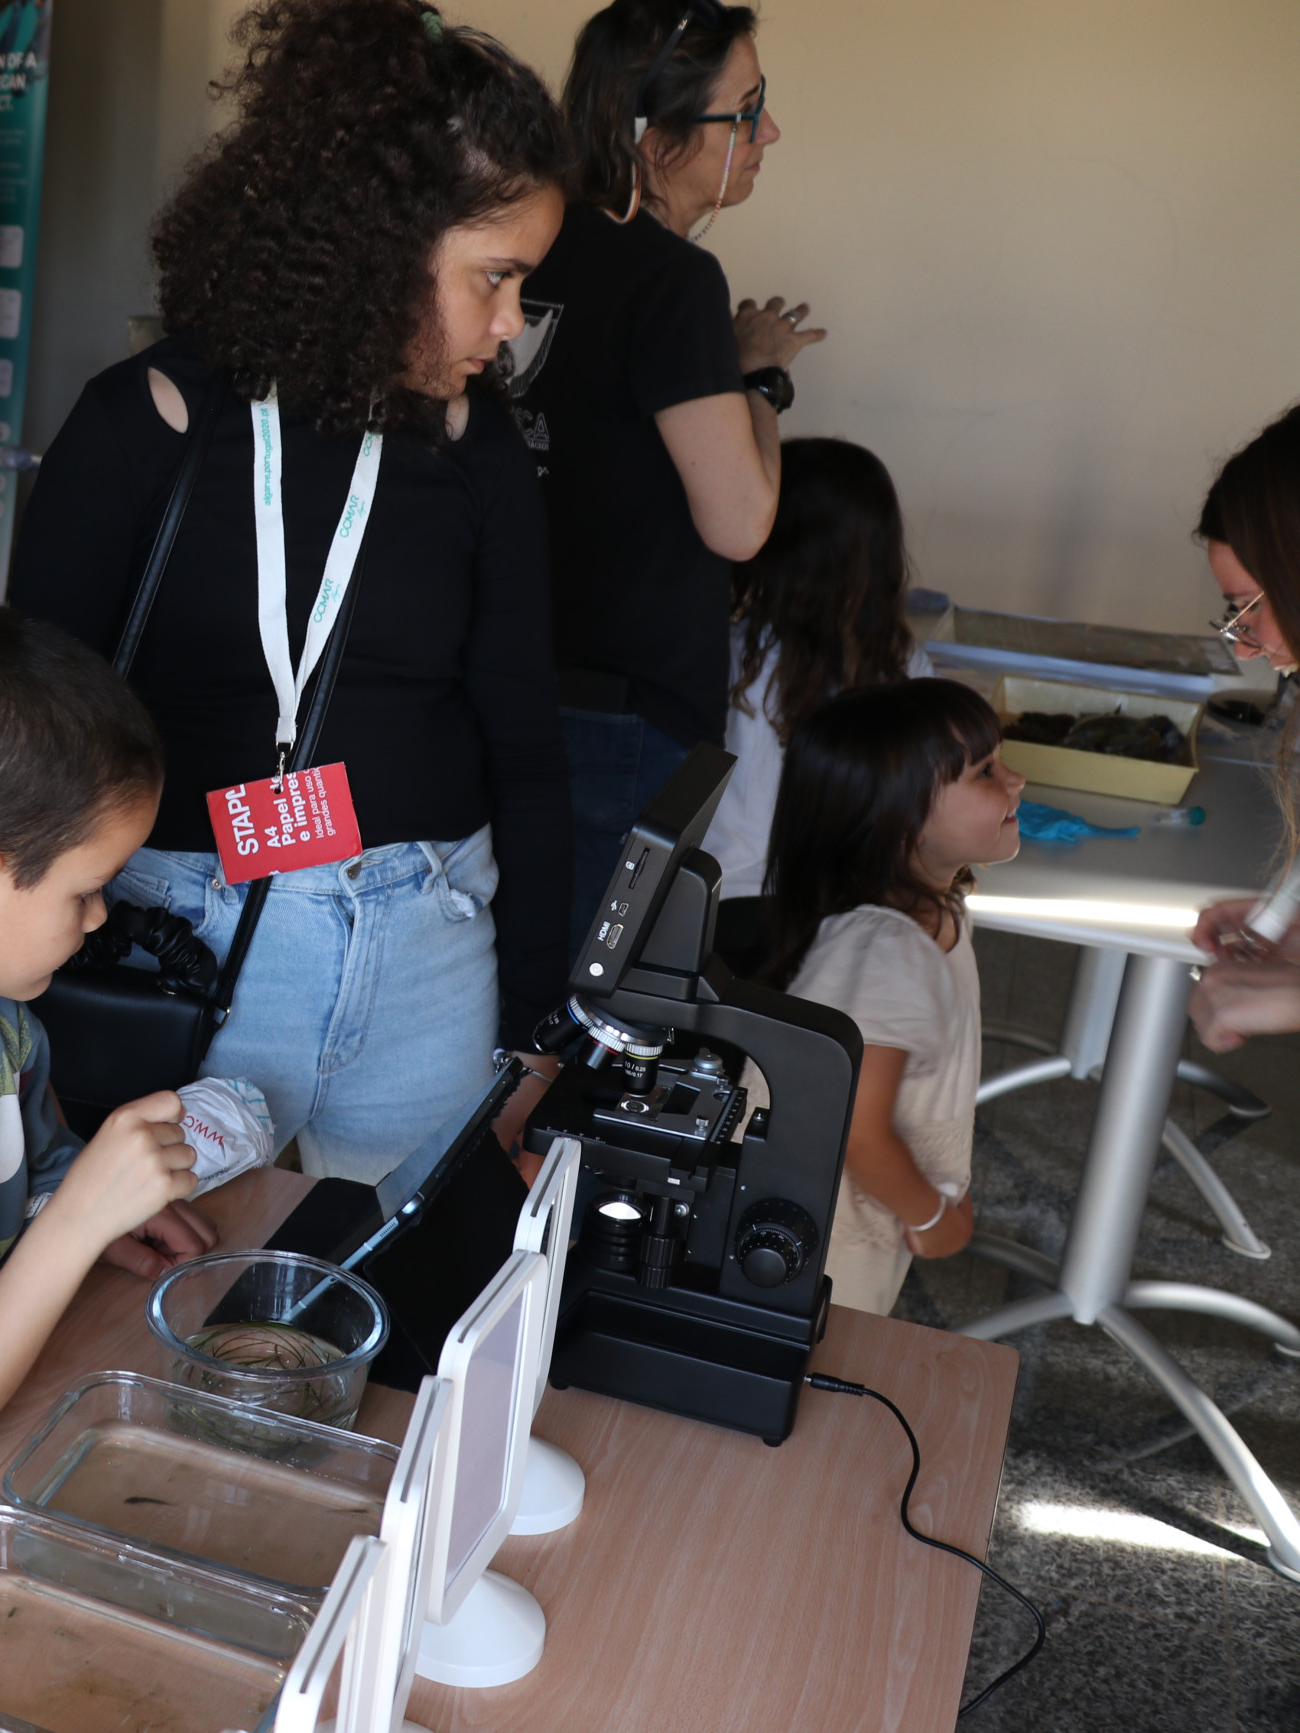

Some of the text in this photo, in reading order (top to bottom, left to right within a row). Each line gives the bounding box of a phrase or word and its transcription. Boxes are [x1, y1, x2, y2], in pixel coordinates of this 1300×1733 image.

[7, 52, 25, 69] OF
[25, 52, 37, 68] A
[260, 408, 273, 506] algarve.portugal2020.pt
[339, 494, 360, 539] CCMAR
[313, 578, 334, 624] CCMAR
[304, 776, 314, 794] uso
[308, 794, 321, 816] para
[273, 798, 296, 846] Papel
[312, 817, 324, 839] Ideal
[320, 800, 336, 836] grandes
[264, 825, 282, 848] A4
[299, 830, 311, 842] e
[597, 921, 611, 942] HDMI
